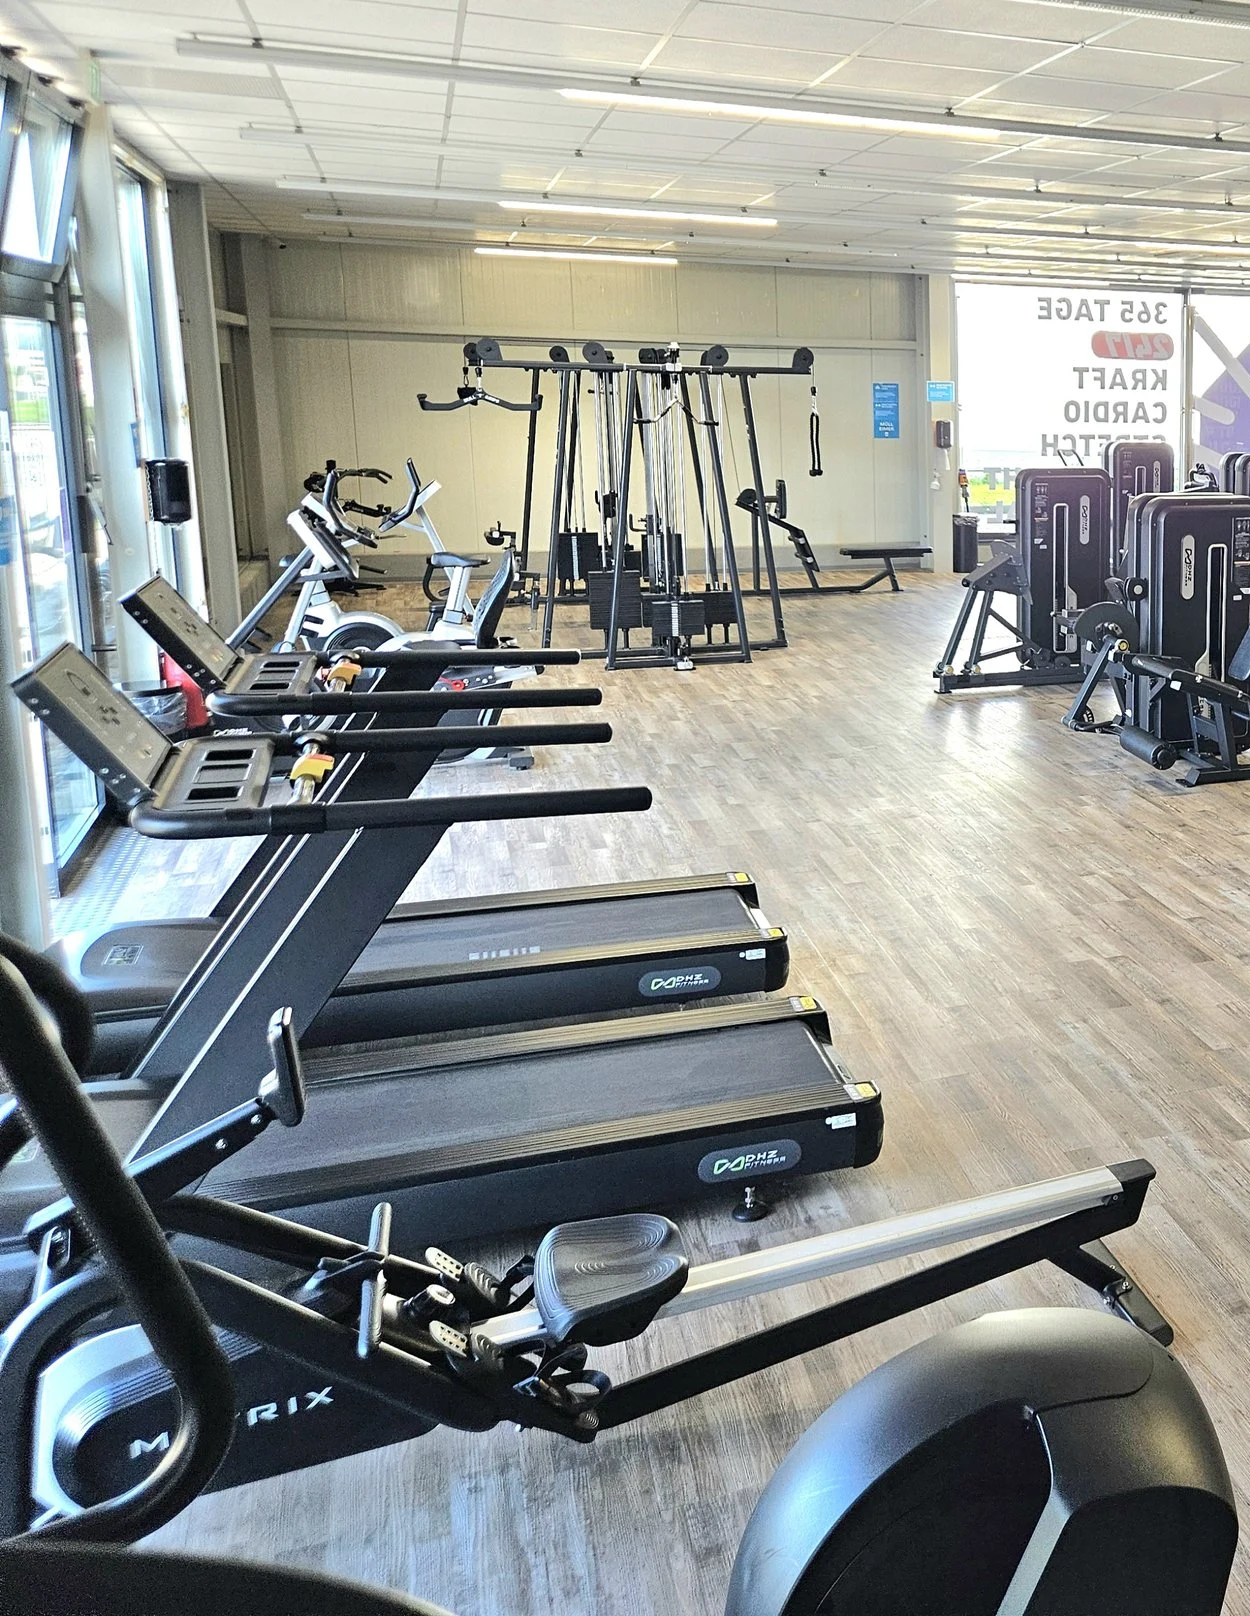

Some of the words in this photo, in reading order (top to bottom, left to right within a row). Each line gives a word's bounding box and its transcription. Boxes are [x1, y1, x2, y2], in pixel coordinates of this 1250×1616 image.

[677, 974, 703, 983] DHZ
[745, 1150, 779, 1163] DHZ
[129, 1386, 334, 1459] MRIX
